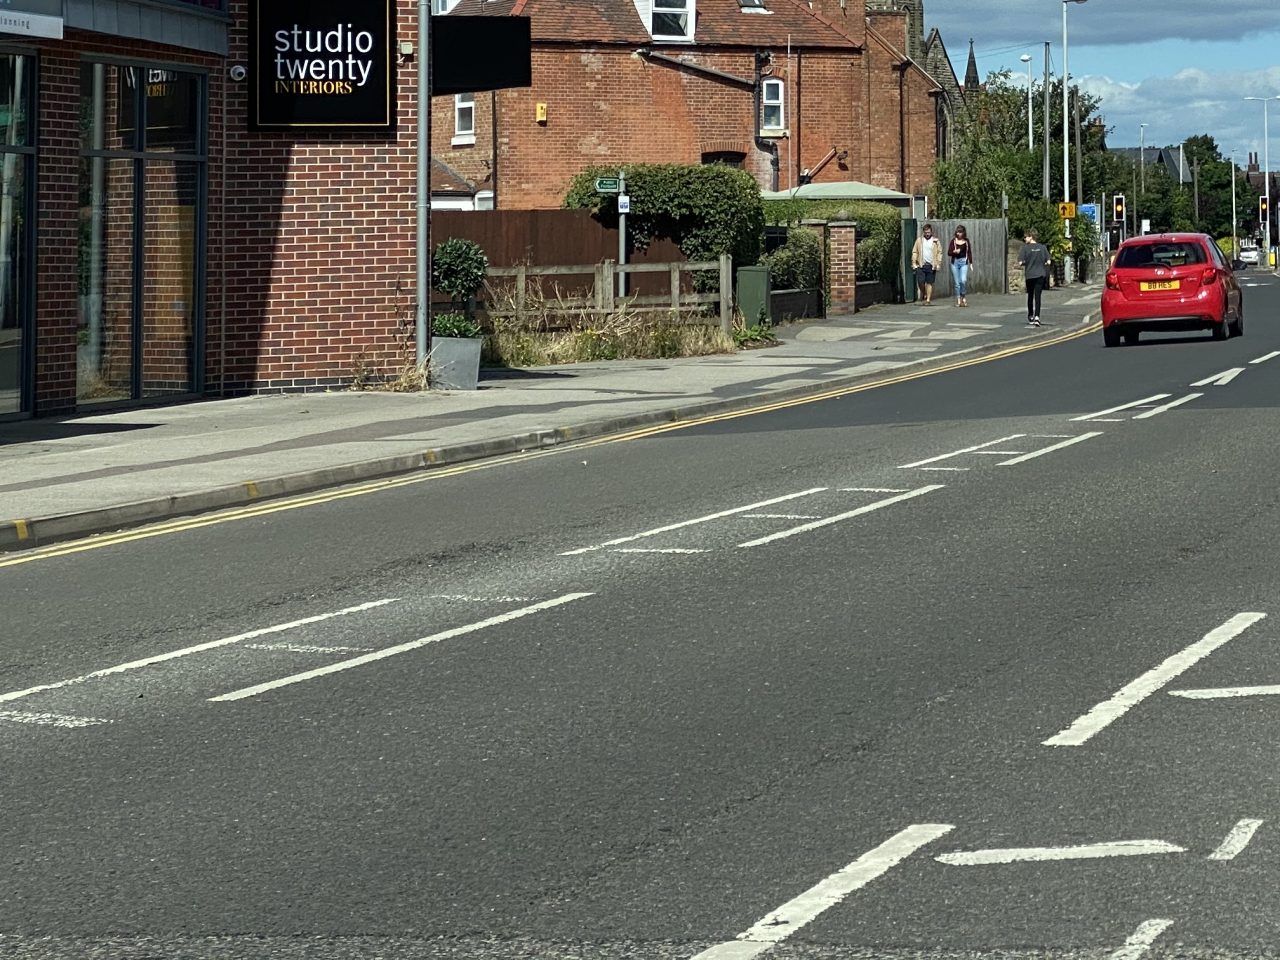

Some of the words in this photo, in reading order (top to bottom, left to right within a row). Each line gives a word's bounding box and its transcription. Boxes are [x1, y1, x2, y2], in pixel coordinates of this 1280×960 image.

[274, 23, 373, 54] studio
[274, 53, 373, 87] twenty
[274, 80, 353, 95] INTERIORS
